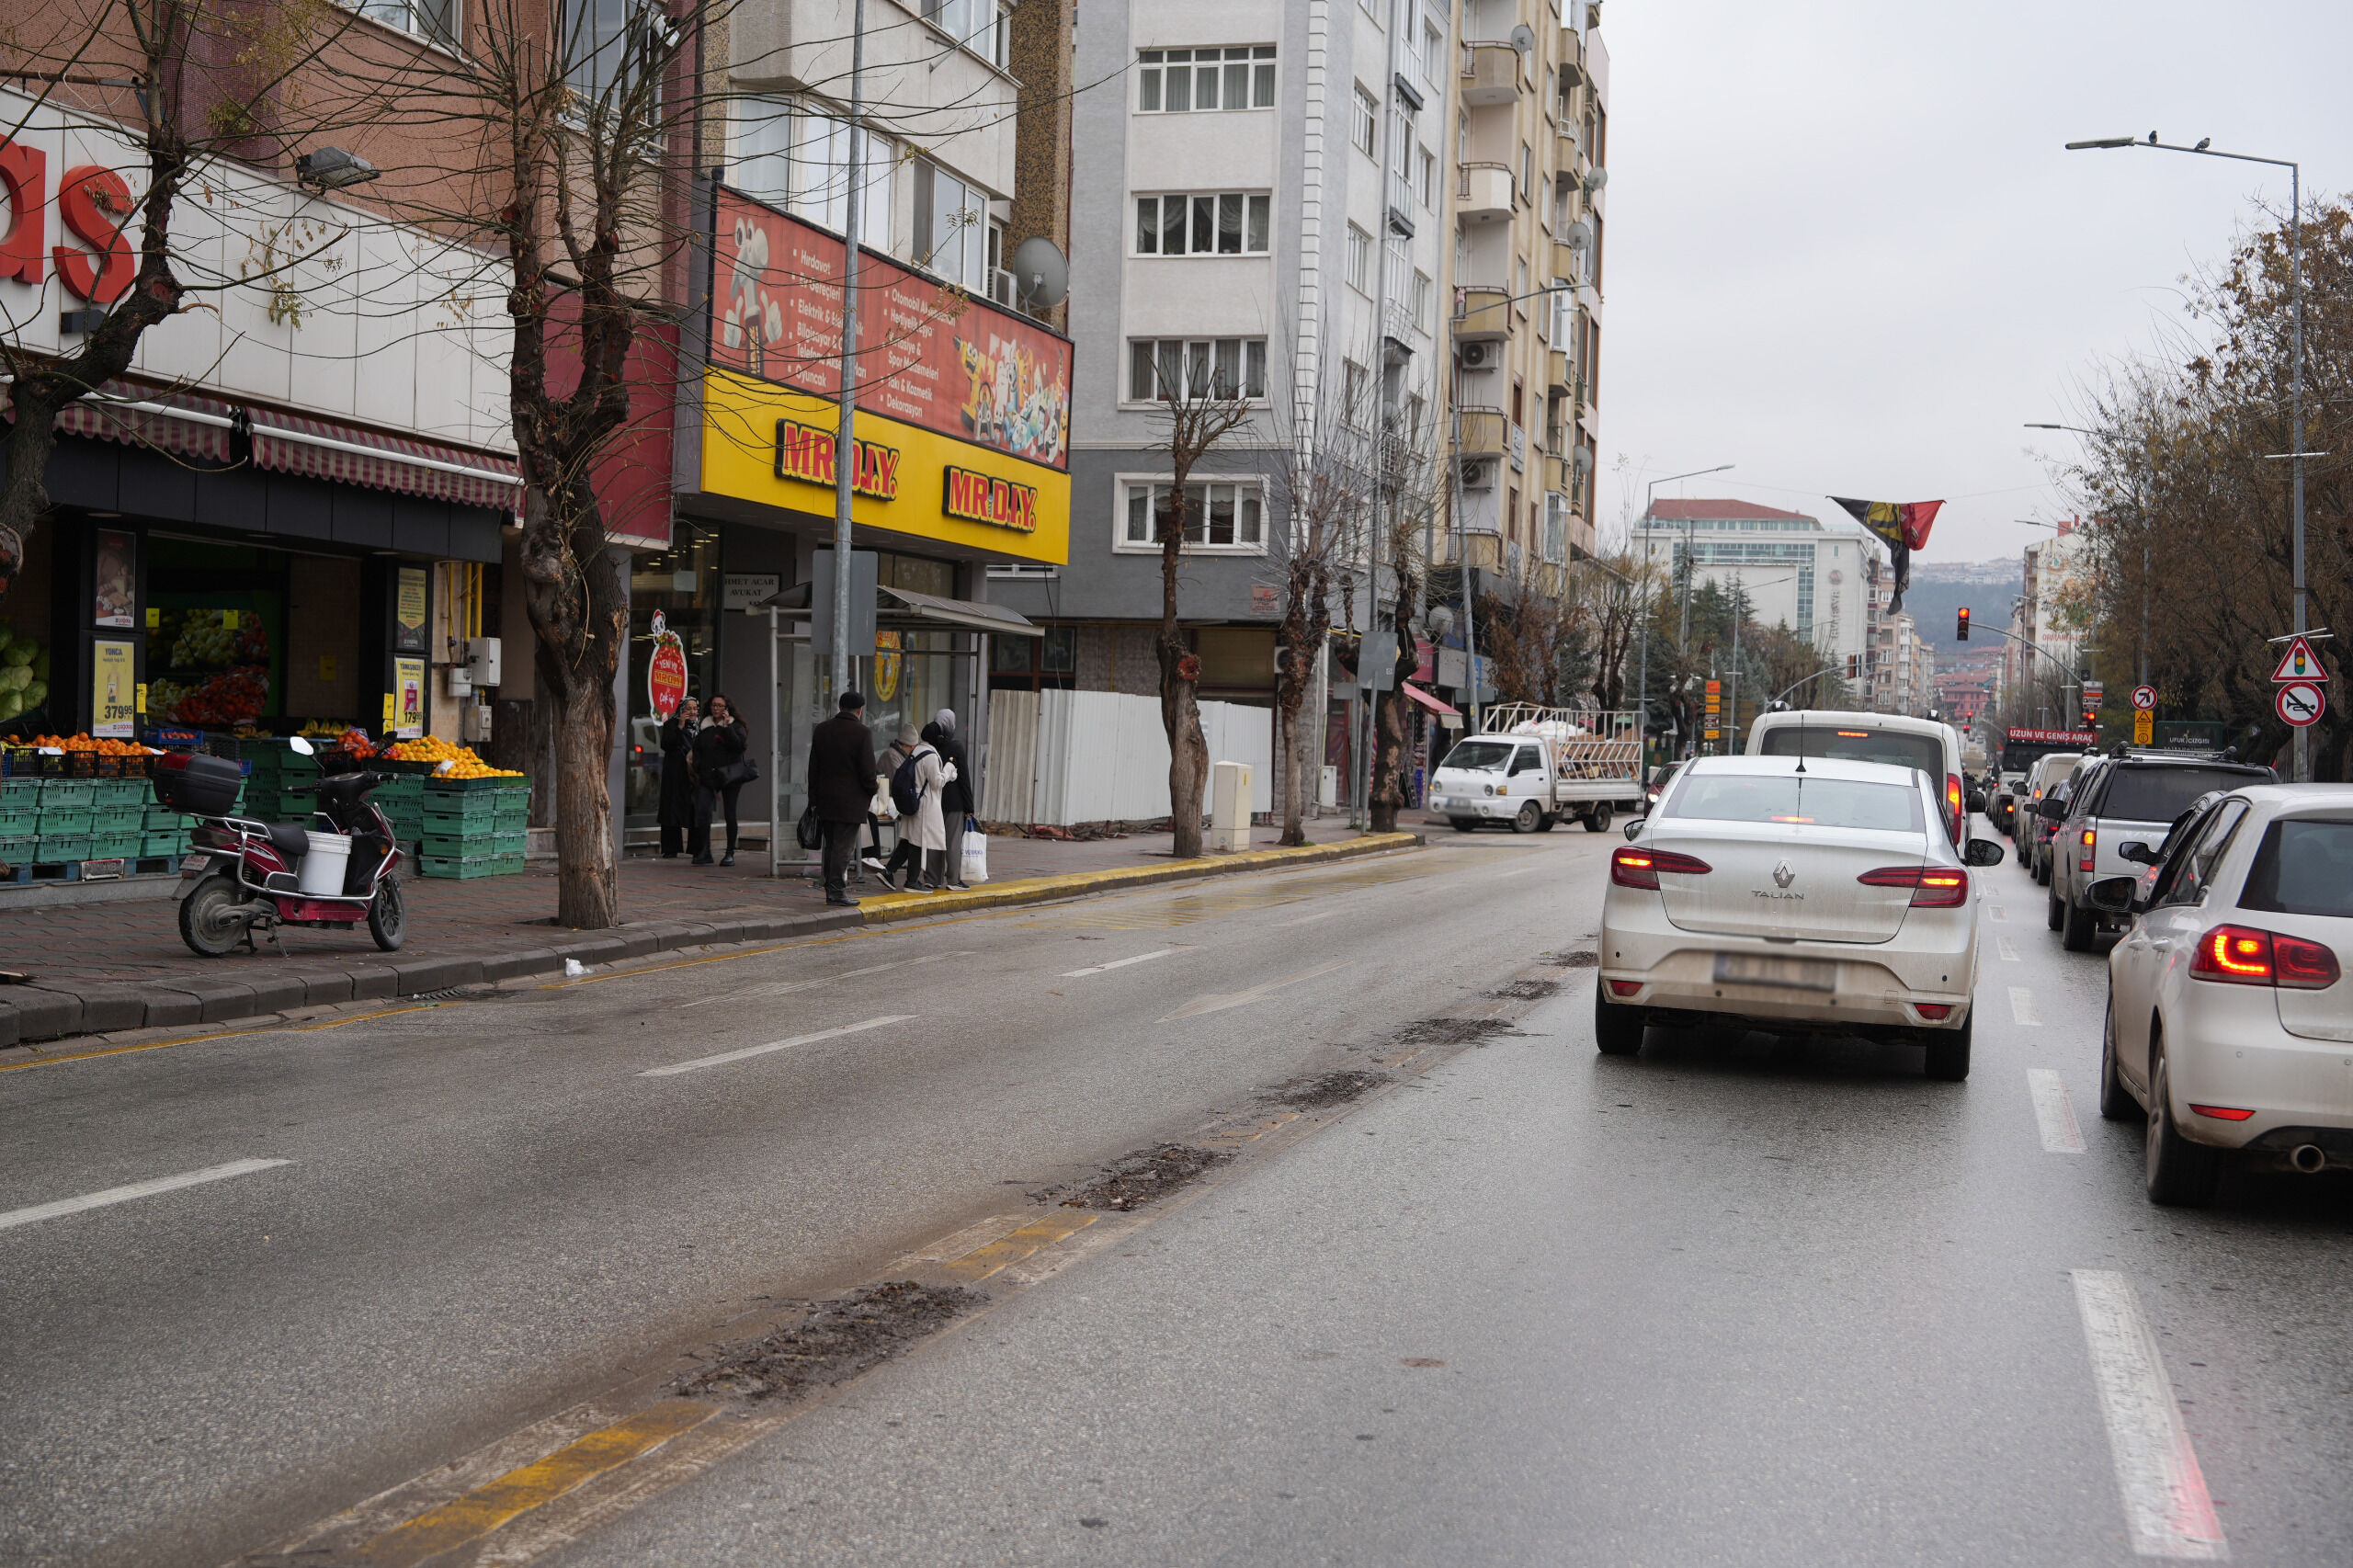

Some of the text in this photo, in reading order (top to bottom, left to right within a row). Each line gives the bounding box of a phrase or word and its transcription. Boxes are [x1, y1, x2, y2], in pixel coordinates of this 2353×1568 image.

[801, 250, 831, 275] Hırdavat
[798, 299, 824, 322] Elektrik
[824, 309, 830, 324] &
[892, 288, 919, 312] Otomobil
[797, 322, 831, 347] Bilgisayar
[888, 350, 903, 368] Spor
[916, 342, 922, 357] &
[795, 364, 826, 387] Oyuncak
[901, 378, 905, 392] &
[906, 381, 933, 402] Kozmetik
[887, 393, 923, 418] Dekorasyon
[782, 422, 837, 485] MR
[949, 468, 990, 520] MR
[2009, 729, 2032, 738] UZUN
[2046, 732, 2071, 743] GENİŞ
[2071, 733, 2094, 742] ARAÇ
[1751, 890, 1804, 900] TALIAN
